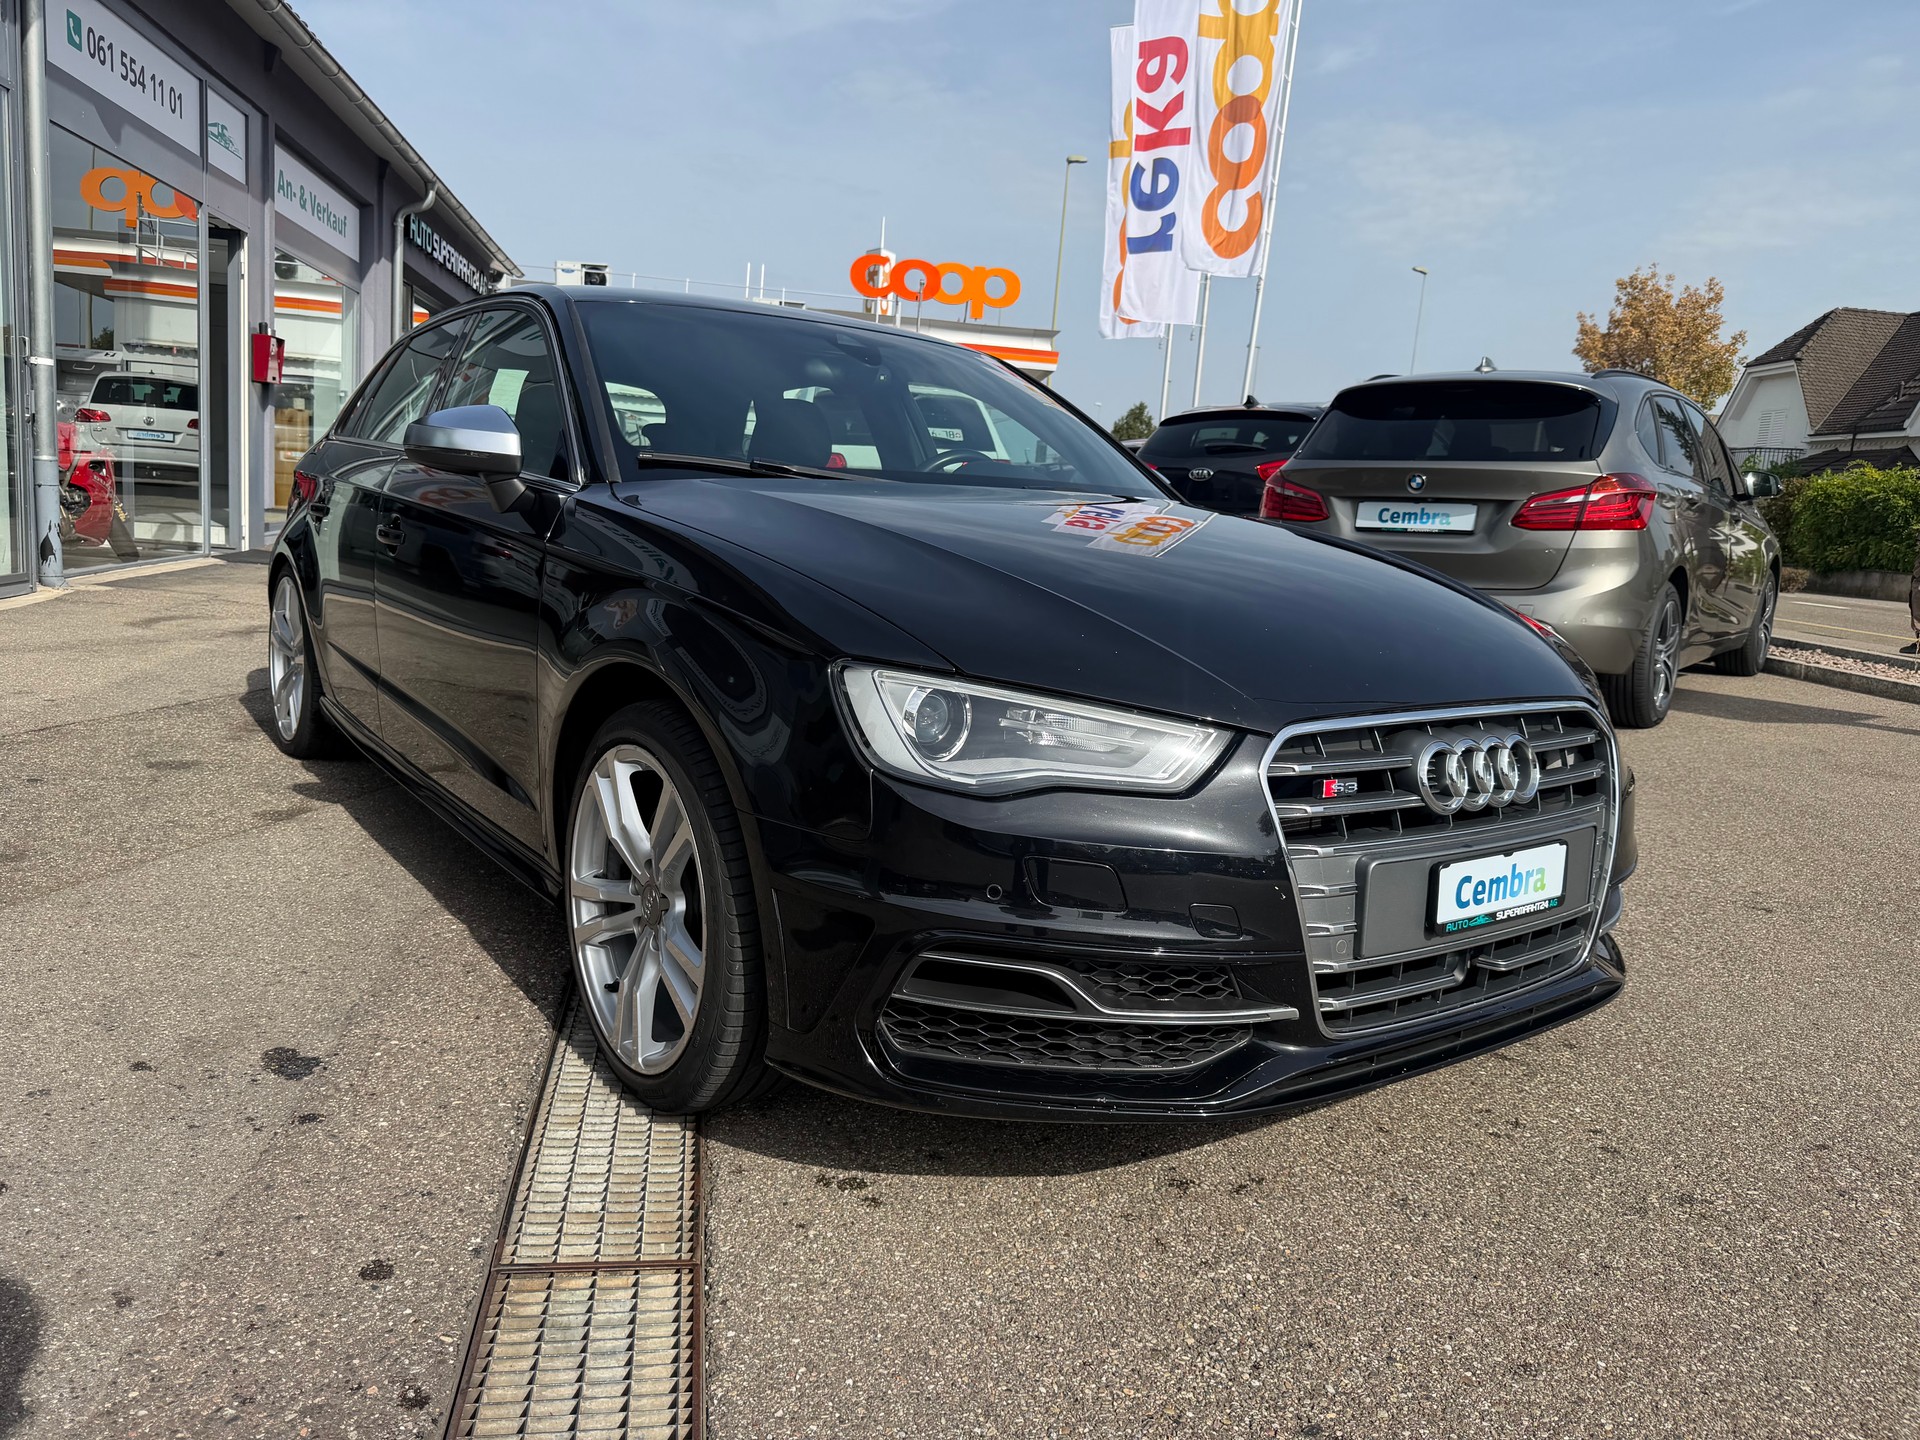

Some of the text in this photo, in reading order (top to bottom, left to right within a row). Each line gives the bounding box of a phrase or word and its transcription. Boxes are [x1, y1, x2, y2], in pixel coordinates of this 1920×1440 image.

[87, 26, 183, 120] 061 554 11 01
[277, 168, 347, 238] An- & Verkauf
[410, 213, 433, 254] AUTO
[850, 253, 1022, 320] coop
[1191, 469, 1210, 479] KIA
[1378, 507, 1451, 525] Cembra
[1332, 782, 1358, 793] S3
[1455, 863, 1547, 909] Cembra
[1446, 898, 1559, 932] AUTO SUPERMARKT24 AG
